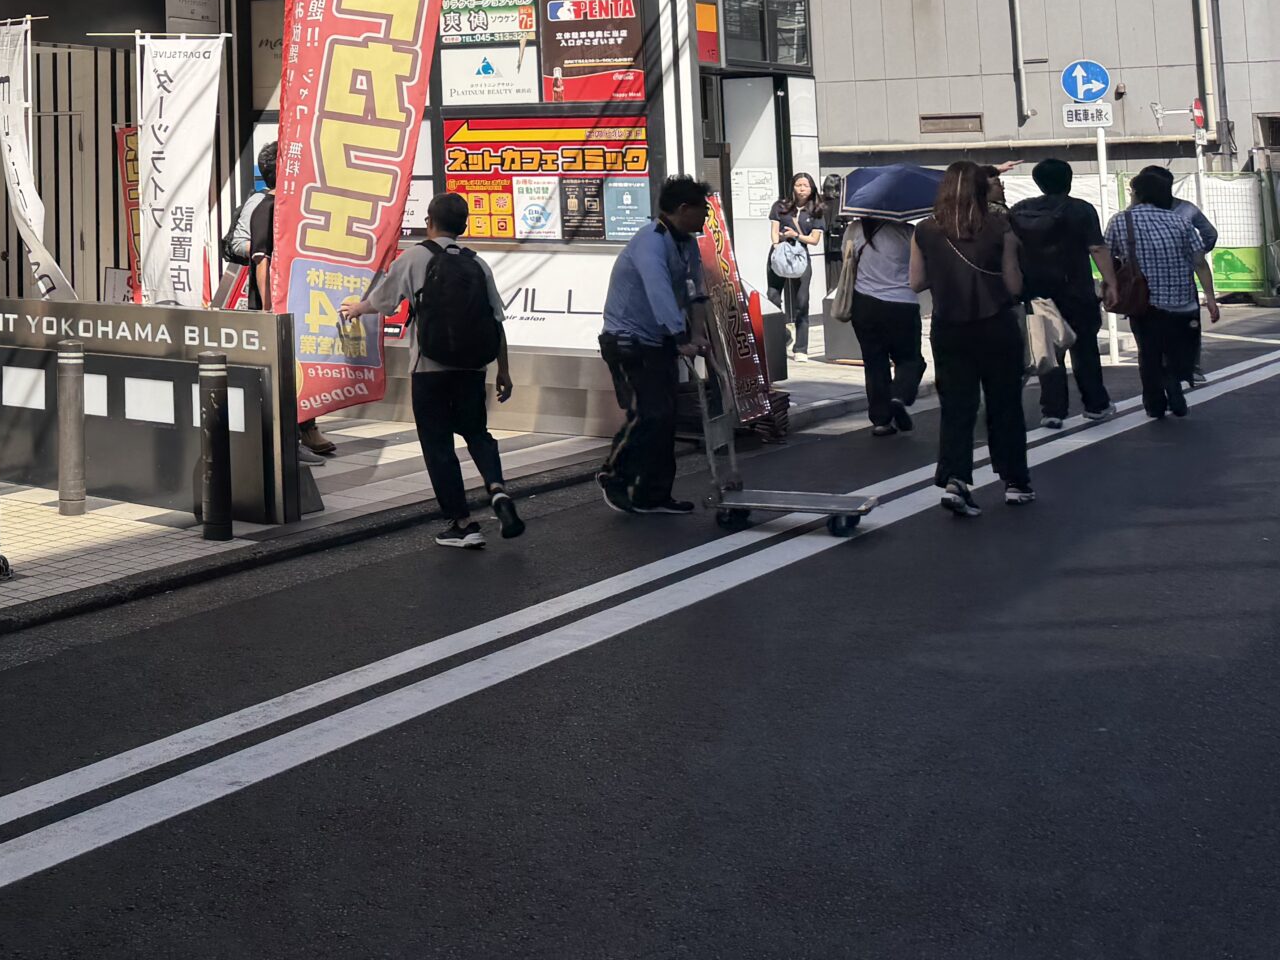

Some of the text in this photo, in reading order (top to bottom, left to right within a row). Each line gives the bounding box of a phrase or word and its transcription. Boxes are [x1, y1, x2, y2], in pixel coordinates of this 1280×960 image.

[520, 14, 534, 29] 7F
[449, 88, 485, 98] PLATINUM
[1066, 108, 1110, 123] 自転車を除く
[447, 146, 649, 173] ネットカフェ コミック
[25, 315, 172, 344] YOKOHAMA
[184, 325, 267, 351] BLDG.
